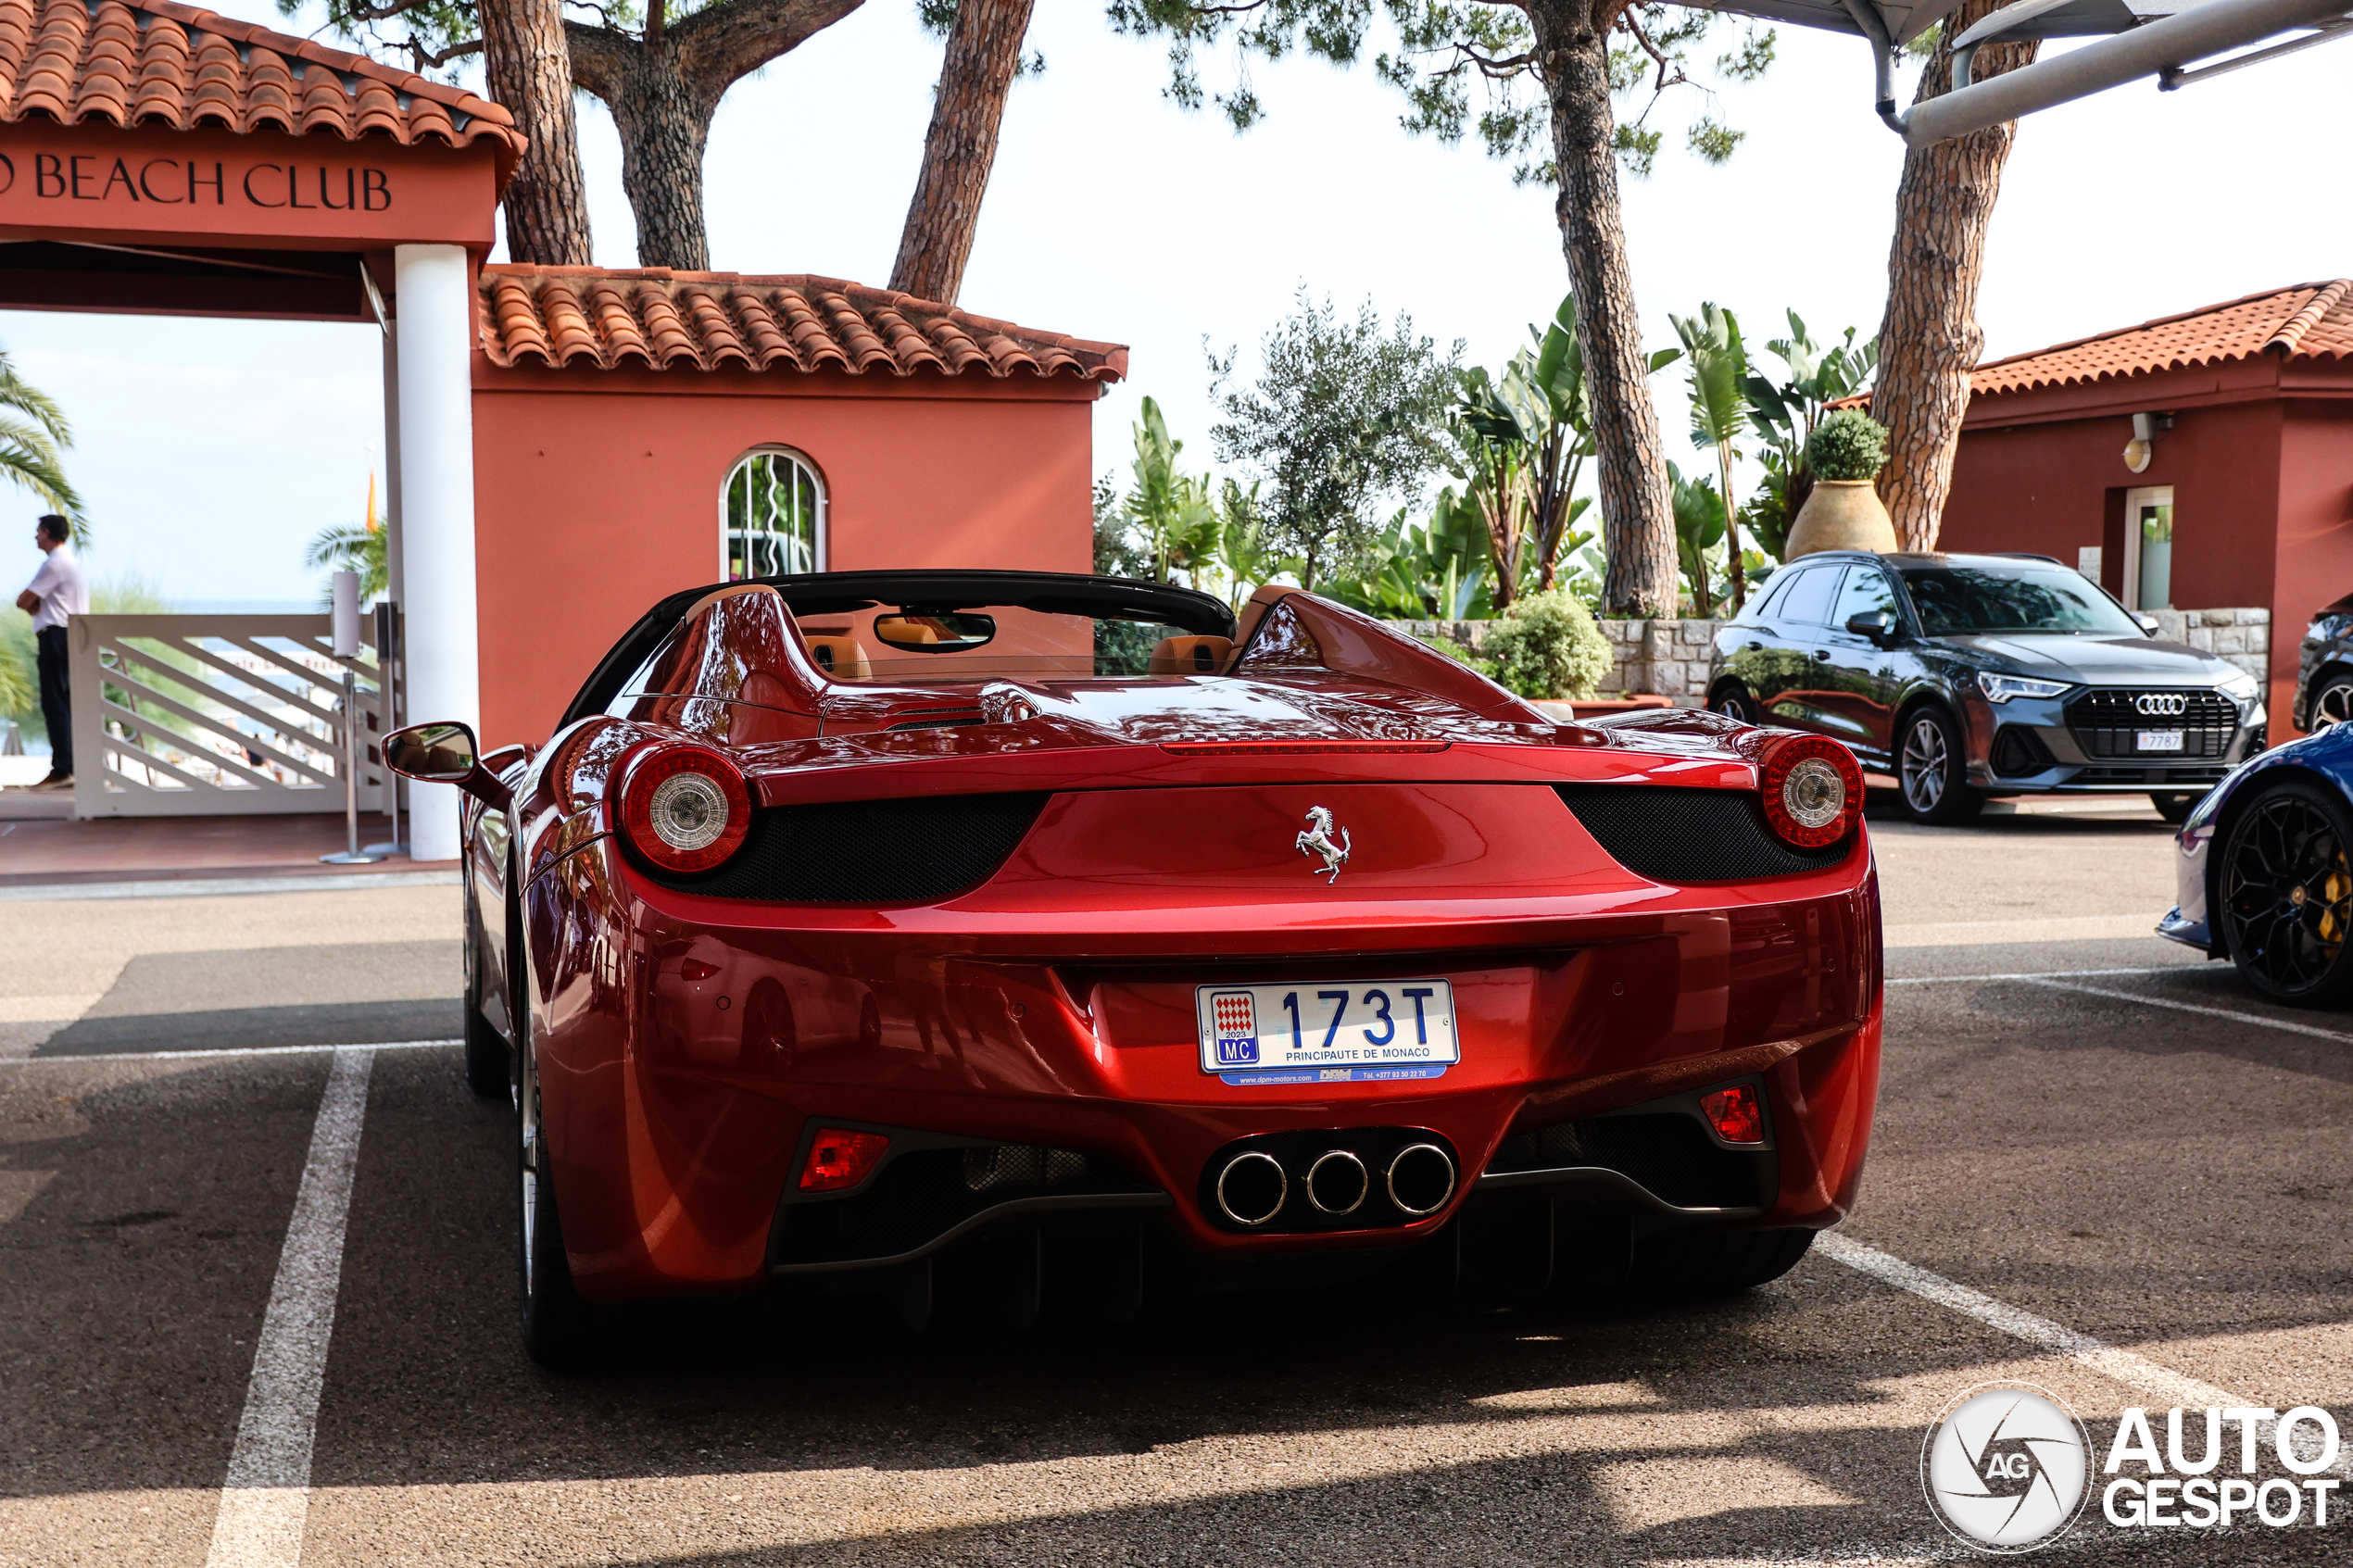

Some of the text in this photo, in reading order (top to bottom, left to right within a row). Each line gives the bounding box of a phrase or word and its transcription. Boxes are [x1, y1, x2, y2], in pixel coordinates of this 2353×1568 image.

[35, 154, 224, 205] BEACH
[244, 163, 391, 211] CLUB
[2149, 735, 2179, 747] 7787
[1282, 987, 1434, 1048] 173T
[1225, 1041, 1250, 1060] MC
[1286, 1047, 1430, 1061] PRINCIPAUTE DE MONACO
[1239, 1075, 1312, 1084] www.dpm-motors.com
